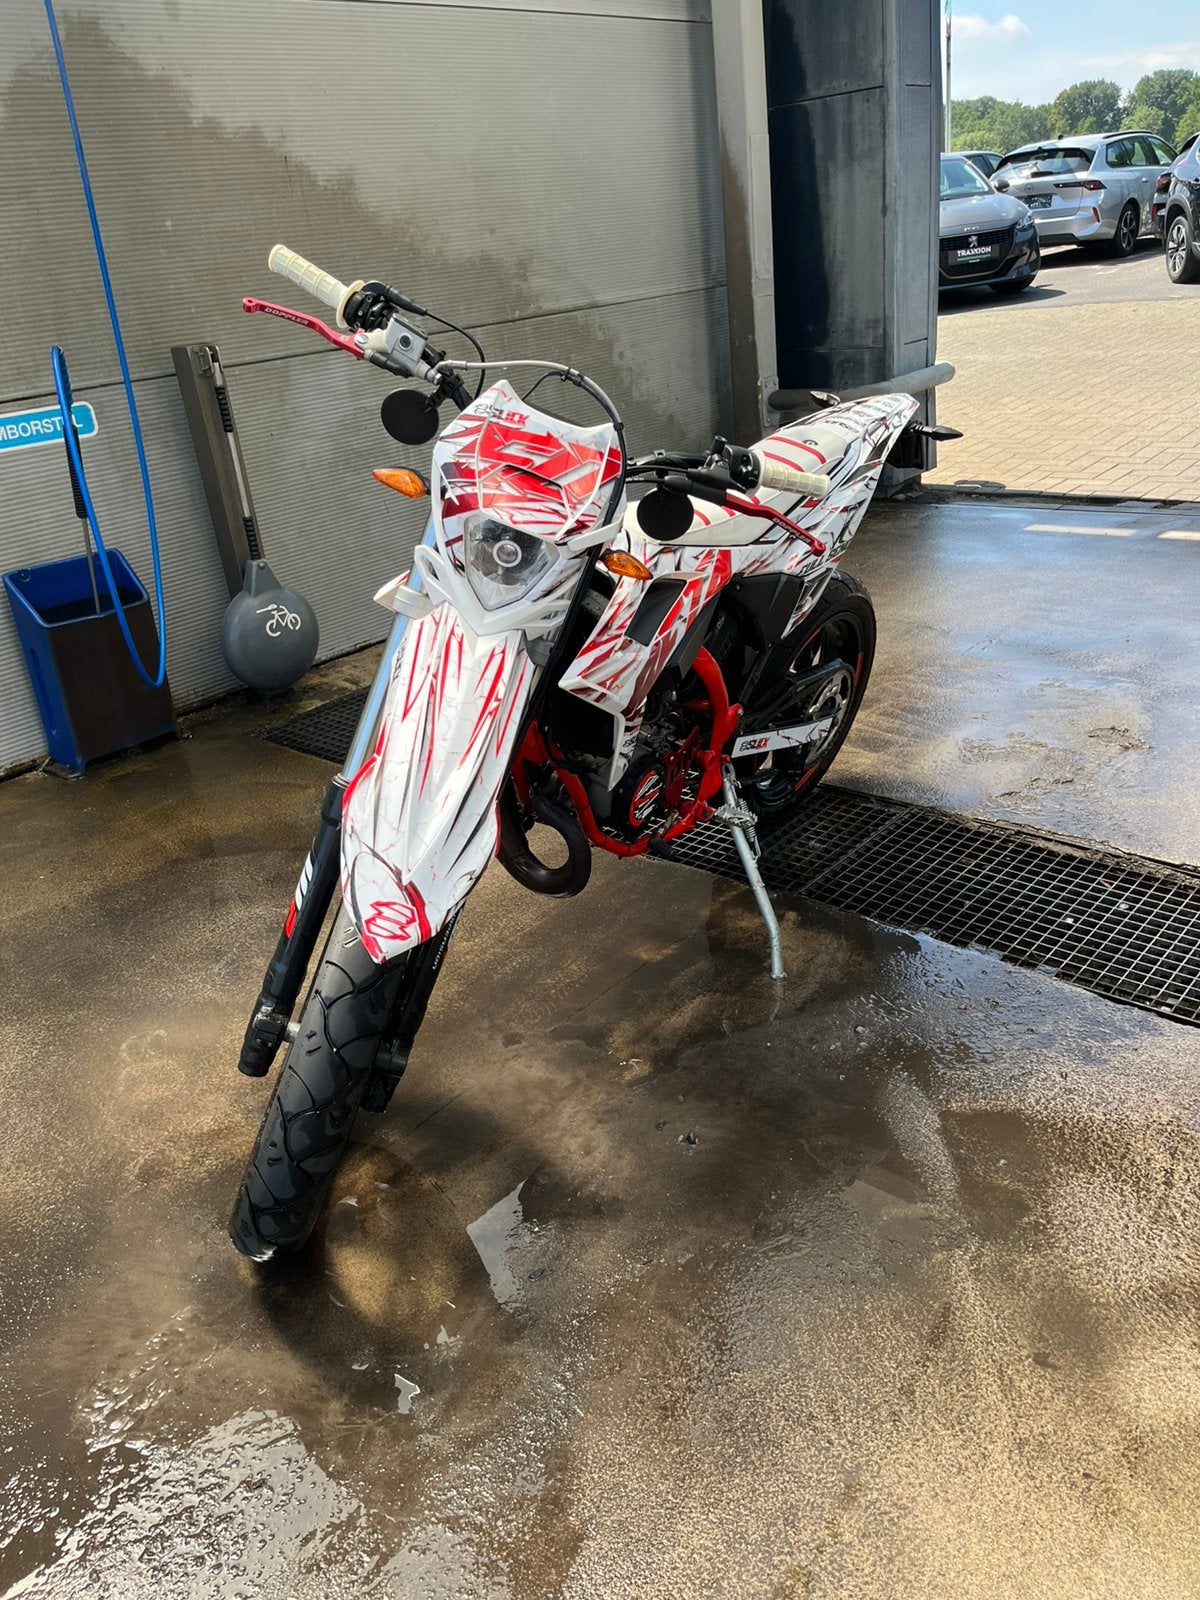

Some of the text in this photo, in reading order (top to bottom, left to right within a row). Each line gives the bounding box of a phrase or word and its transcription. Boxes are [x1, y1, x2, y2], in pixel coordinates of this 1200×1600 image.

[957, 246, 991, 257] TRAXXION
[264, 307, 309, 326] DOPPLER
[0, 414, 84, 441] MBORSTL
[772, 518, 811, 543] DOPPLER
